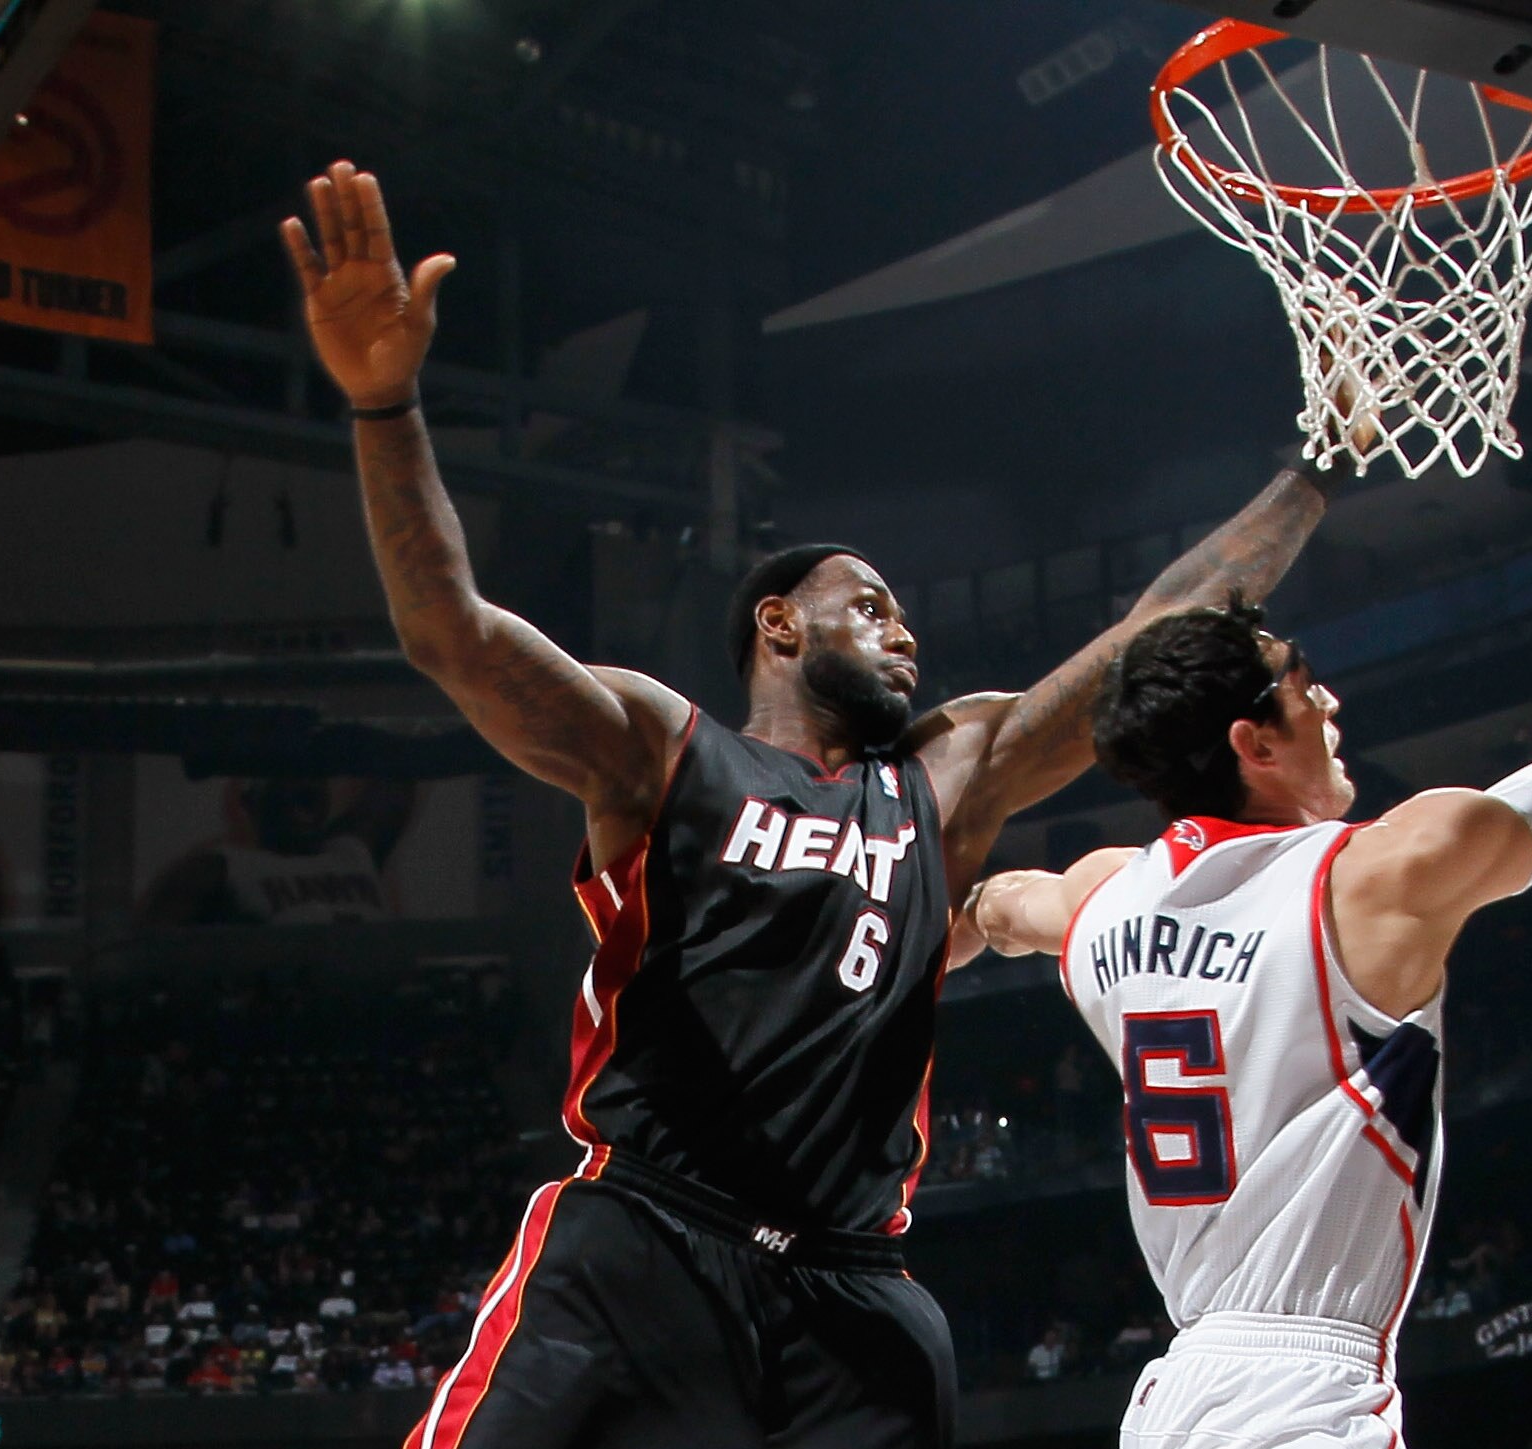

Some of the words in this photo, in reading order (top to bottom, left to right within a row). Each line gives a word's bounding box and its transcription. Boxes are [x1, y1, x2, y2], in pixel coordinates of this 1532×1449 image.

[19, 266, 128, 321] TURNER
[720, 795, 918, 903] HEAT
[837, 906, 891, 993] 6
[1090, 914, 1267, 996] HINRICH
[1121, 1008, 1238, 1207] 6
